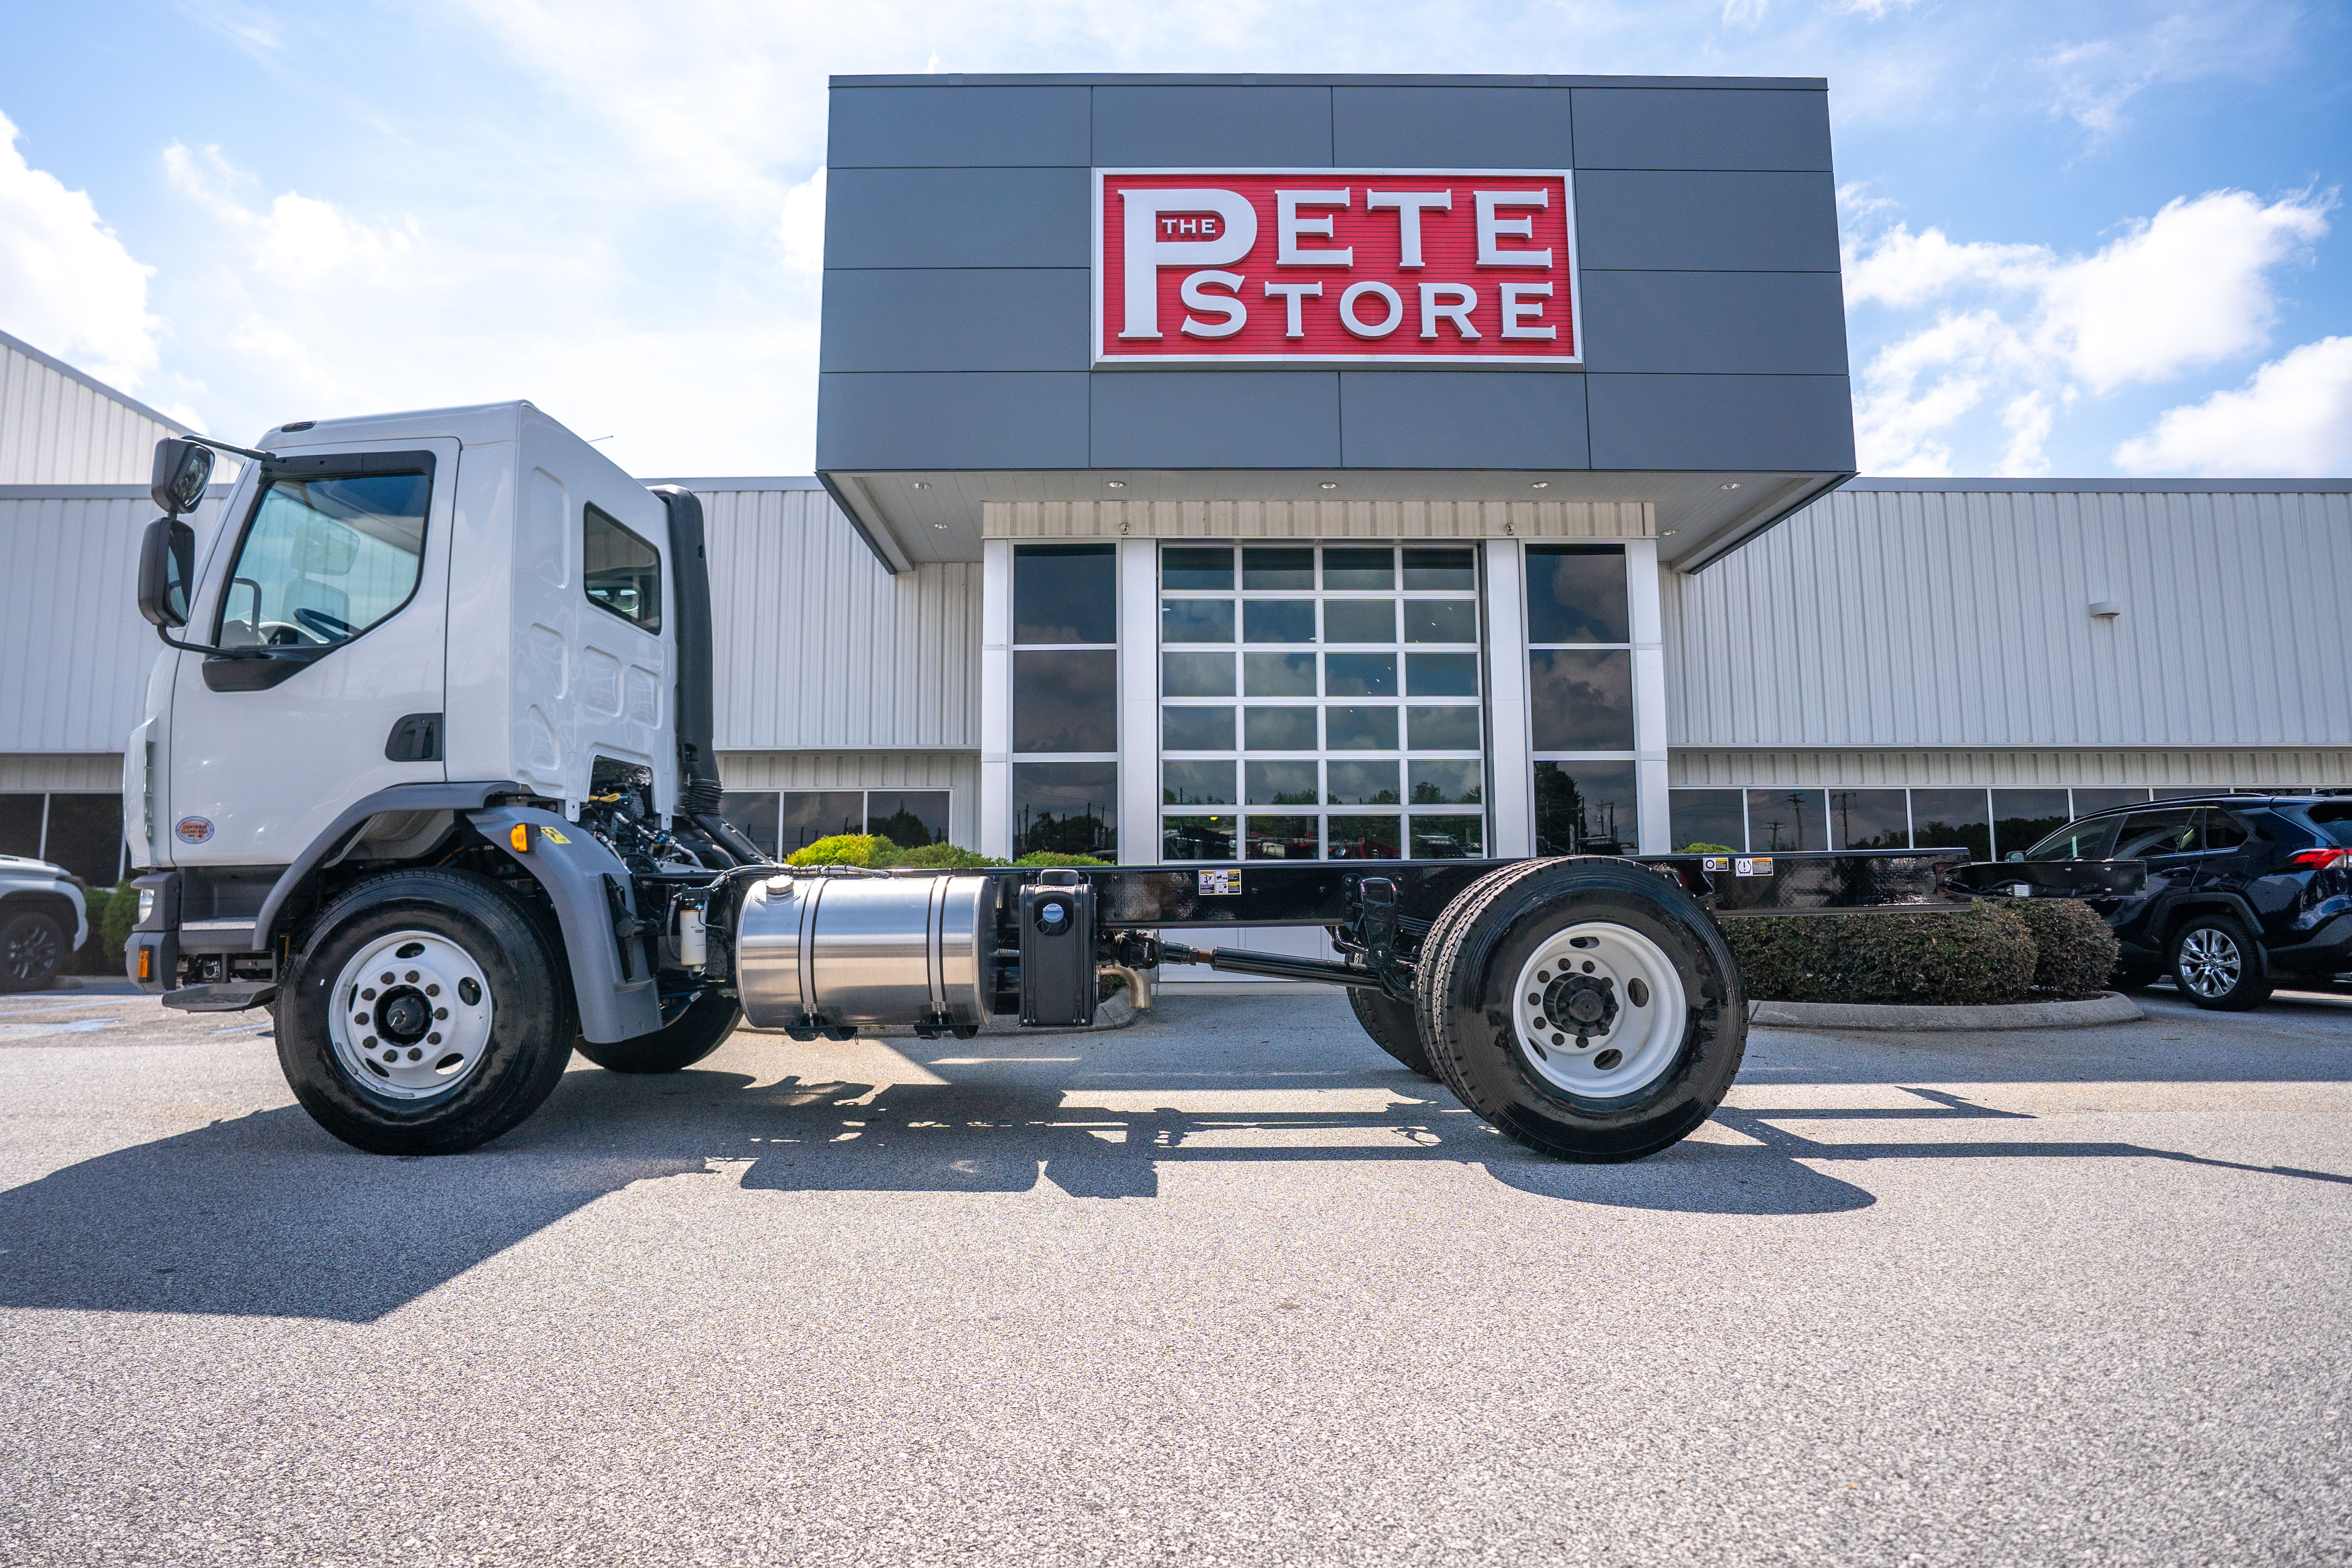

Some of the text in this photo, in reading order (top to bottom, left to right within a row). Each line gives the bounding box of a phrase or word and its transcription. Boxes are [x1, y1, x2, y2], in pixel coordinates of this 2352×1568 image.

[1118, 187, 1553, 341] PETE
[1162, 219, 1216, 236] THE
[1181, 270, 1557, 341] STORE
[1660, 1004, 1720, 1111] YOKOHAMA
